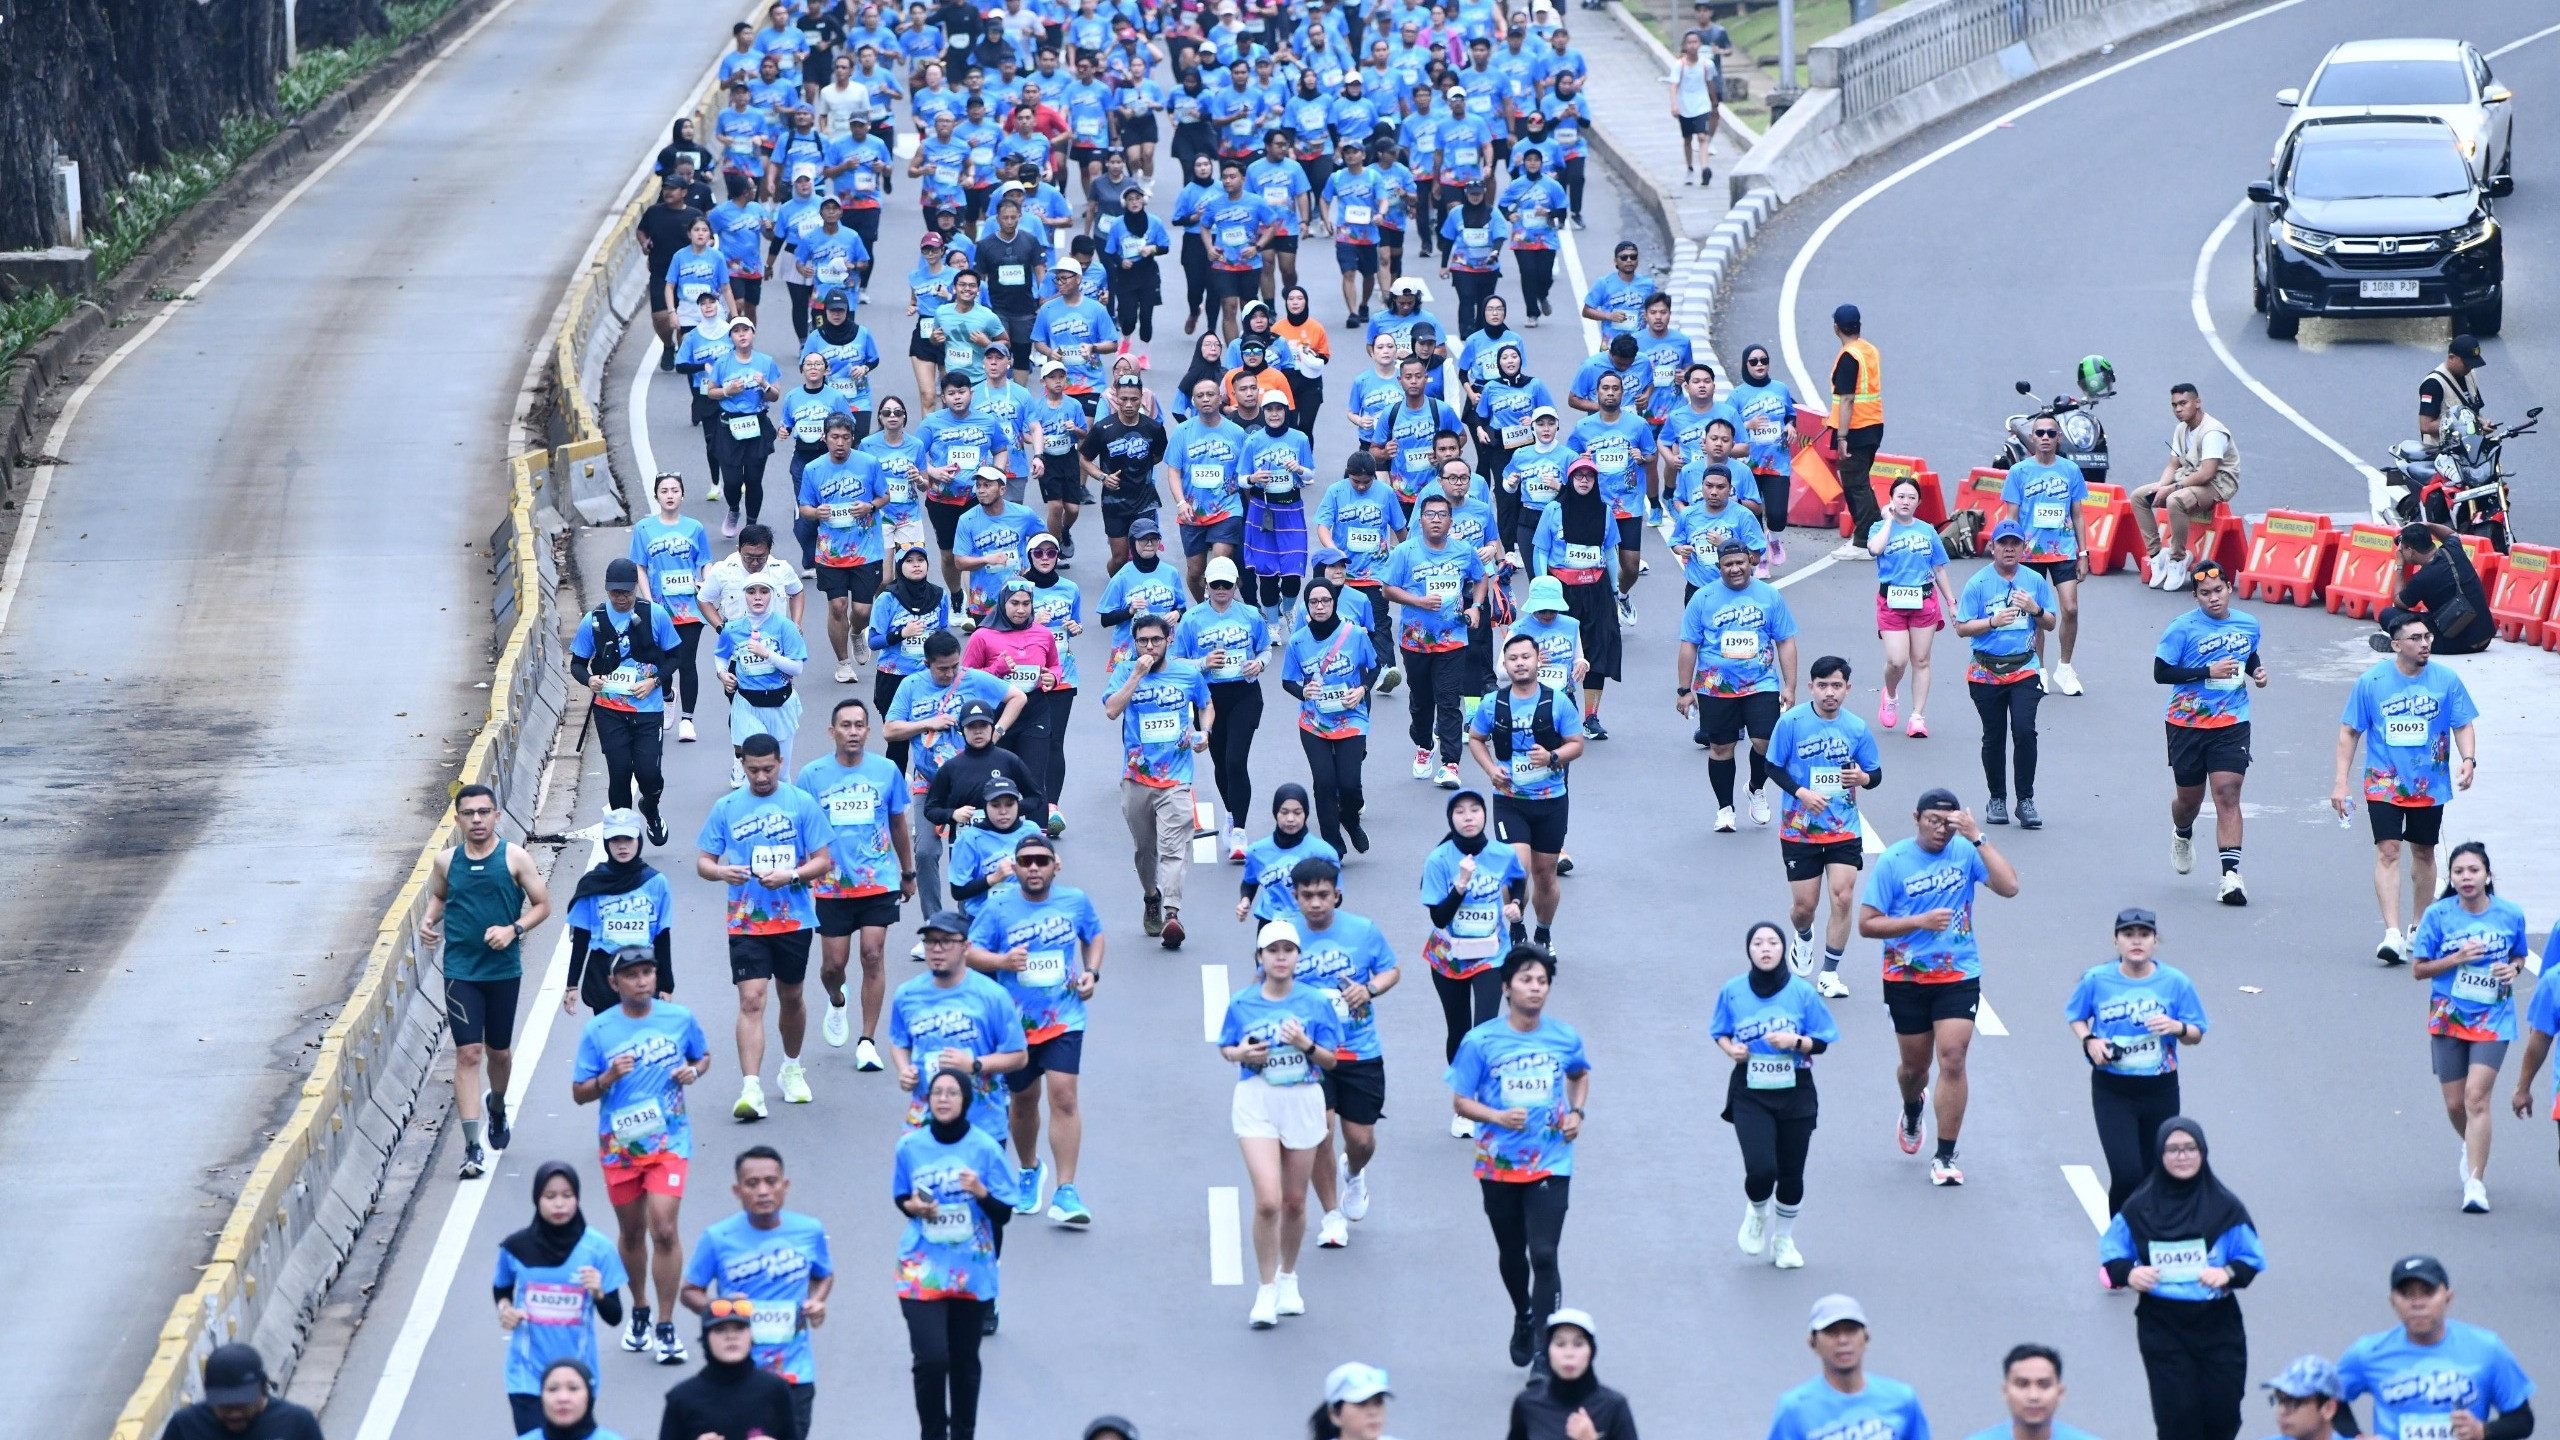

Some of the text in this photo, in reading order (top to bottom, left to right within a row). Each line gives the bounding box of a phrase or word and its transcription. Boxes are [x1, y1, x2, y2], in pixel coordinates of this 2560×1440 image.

[2362, 282, 2368, 292] B
[2401, 282, 2418, 292] PJP
[1506, 428, 1528, 440] 13559
[1600, 454, 1624, 462] 52319
[1195, 470, 1220, 478] 53250
[1351, 534, 1376, 542] 54523
[1569, 551, 1596, 560] 54981
[666, 576, 690, 584] 56111
[1430, 582, 1456, 590] 53999
[1892, 589, 1919, 597] 50745
[1726, 638, 1754, 646] 13995
[1006, 672, 1036, 680] 50350
[1144, 720, 1175, 730] 53735
[2390, 724, 2424, 732] 50693
[1814, 774, 1840, 784] 5083
[836, 800, 868, 811] 52923
[756, 854, 790, 865] 14479
[1458, 910, 1494, 922] 52043
[608, 920, 644, 930] 50422
[1030, 960, 1058, 970] 0501
[2460, 972, 2496, 988] 51268
[2123, 1042, 2155, 1054] 0543
[1752, 1062, 1791, 1073] 52086
[1508, 1080, 1547, 1091] 54631
[616, 1108, 657, 1130] 50438
[2155, 1252, 2202, 1264] 50495
[752, 1312, 790, 1323] 0059
